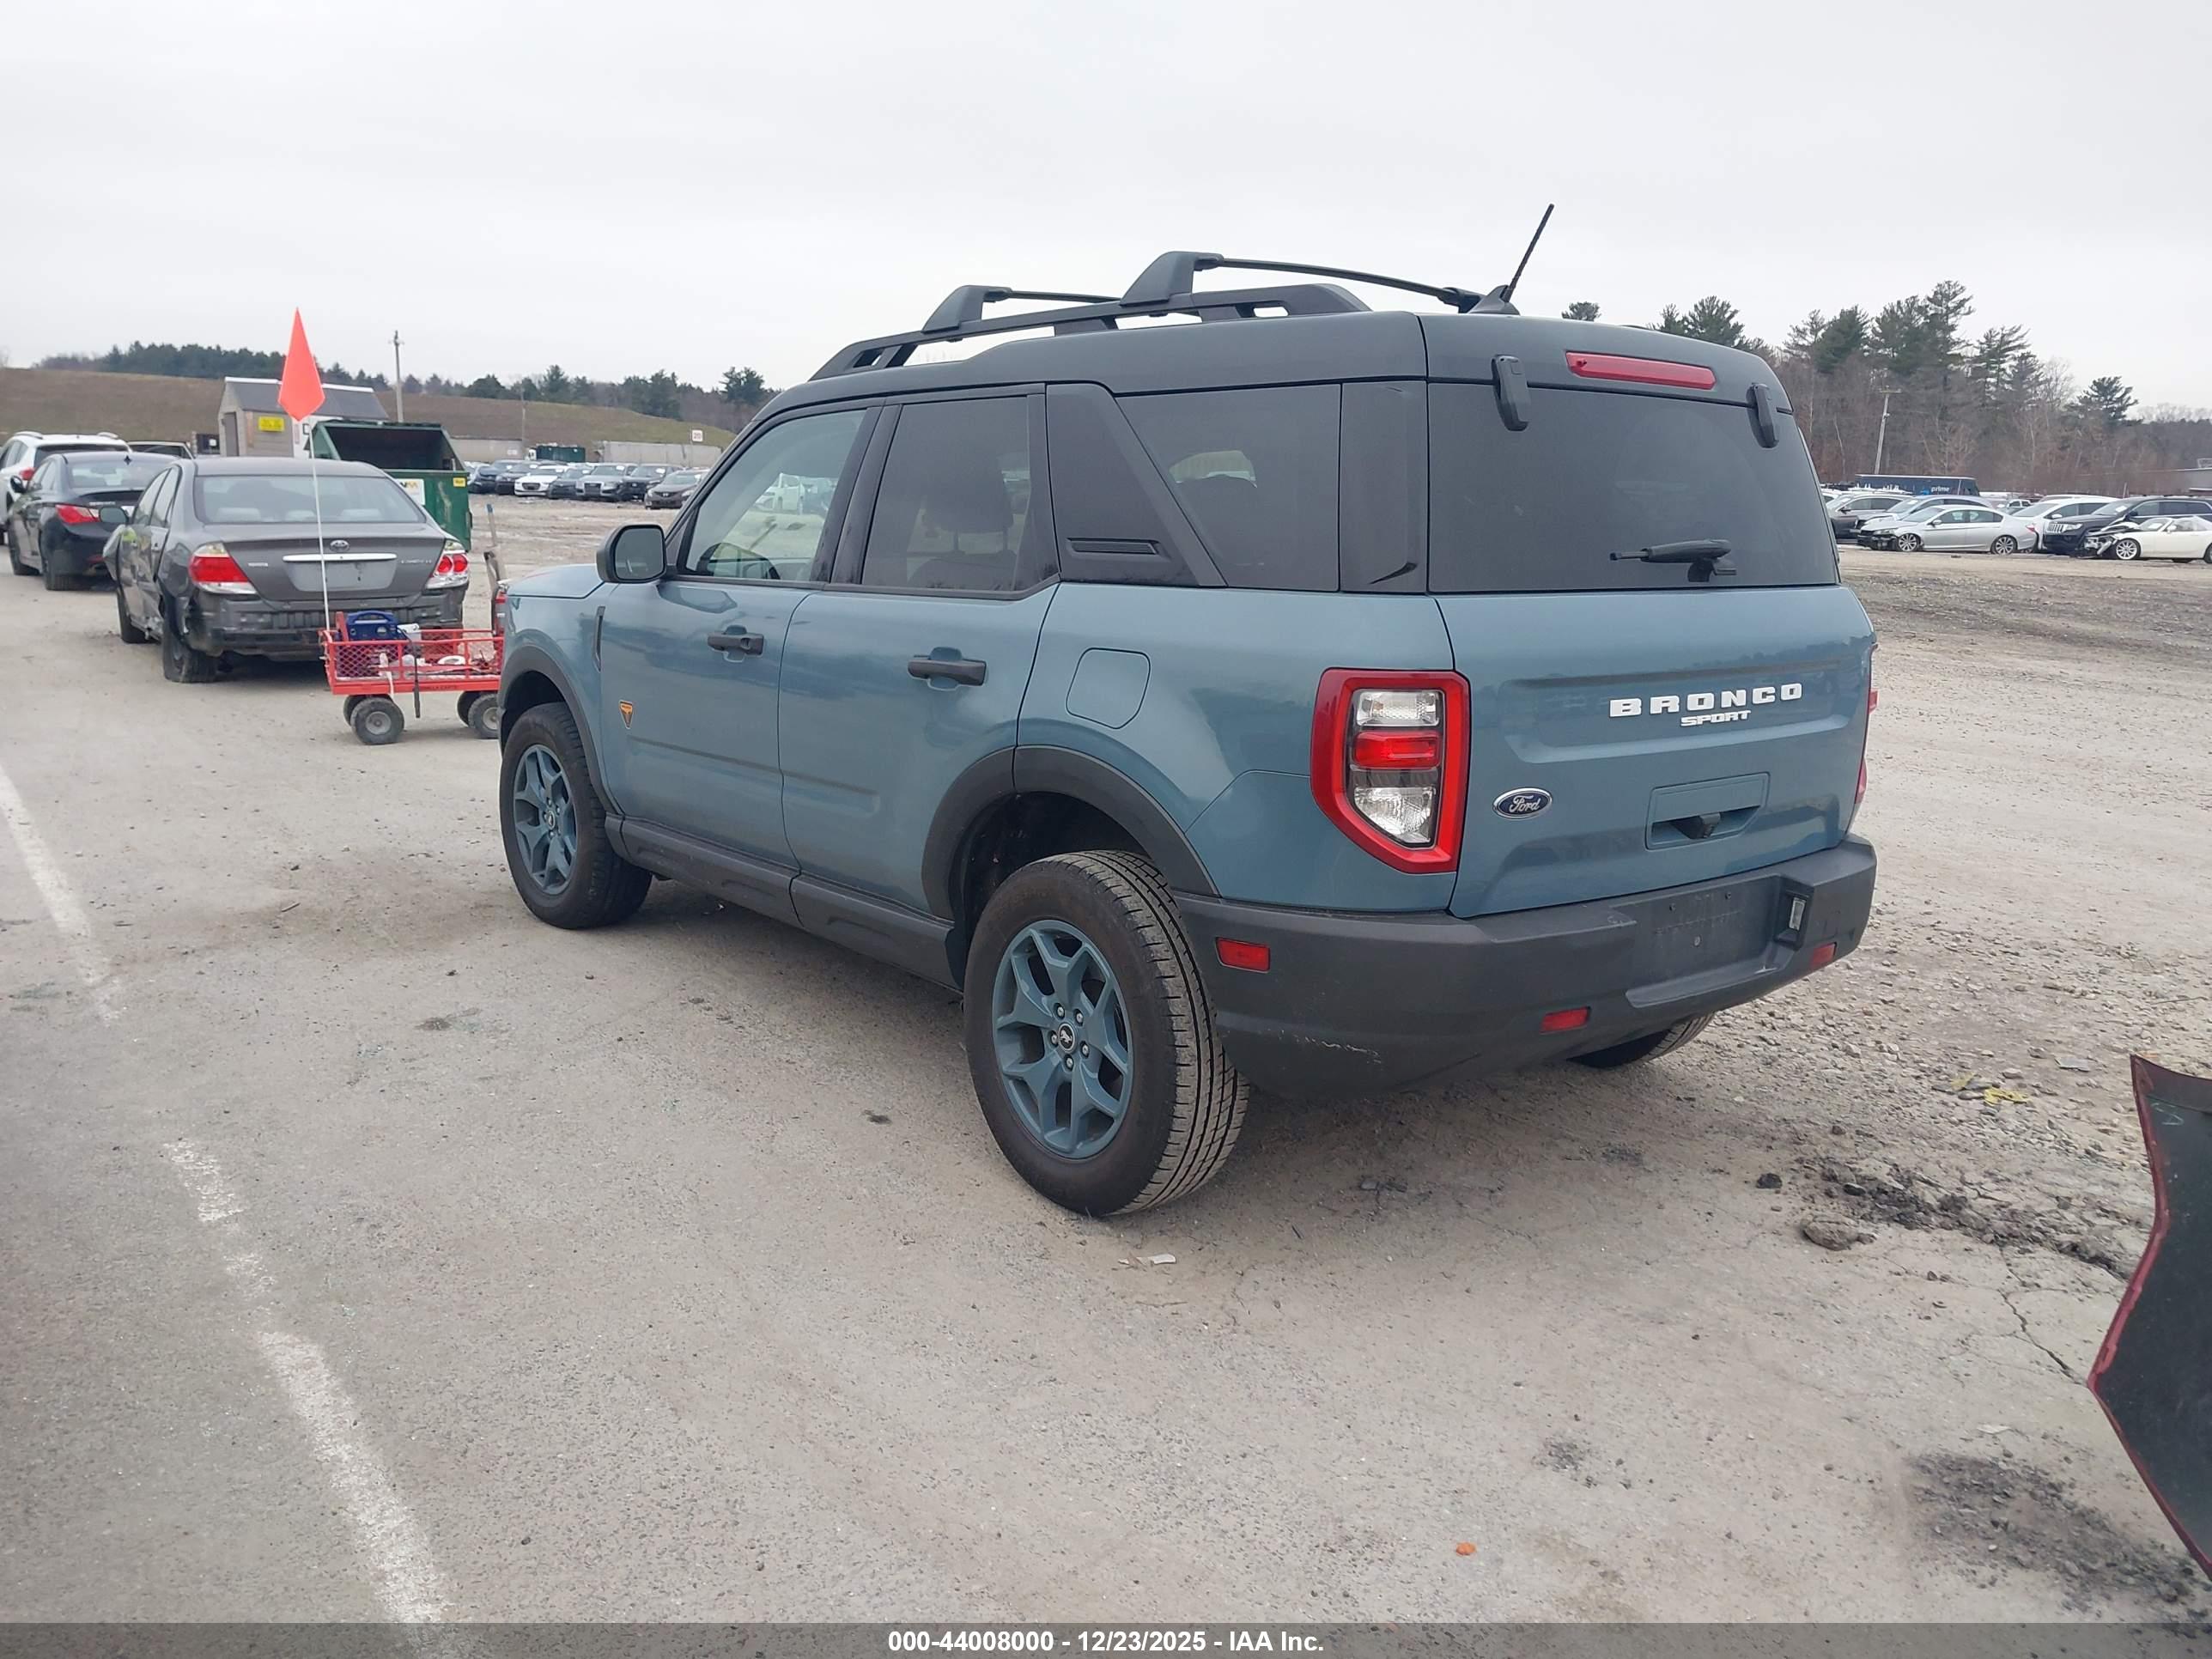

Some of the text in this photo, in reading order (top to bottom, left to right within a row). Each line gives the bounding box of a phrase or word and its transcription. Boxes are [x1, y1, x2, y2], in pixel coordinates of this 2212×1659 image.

[1610, 684, 1802, 717] BRONCO
[1680, 710, 1752, 726] SPORT
[1509, 795, 1541, 812] Ford
